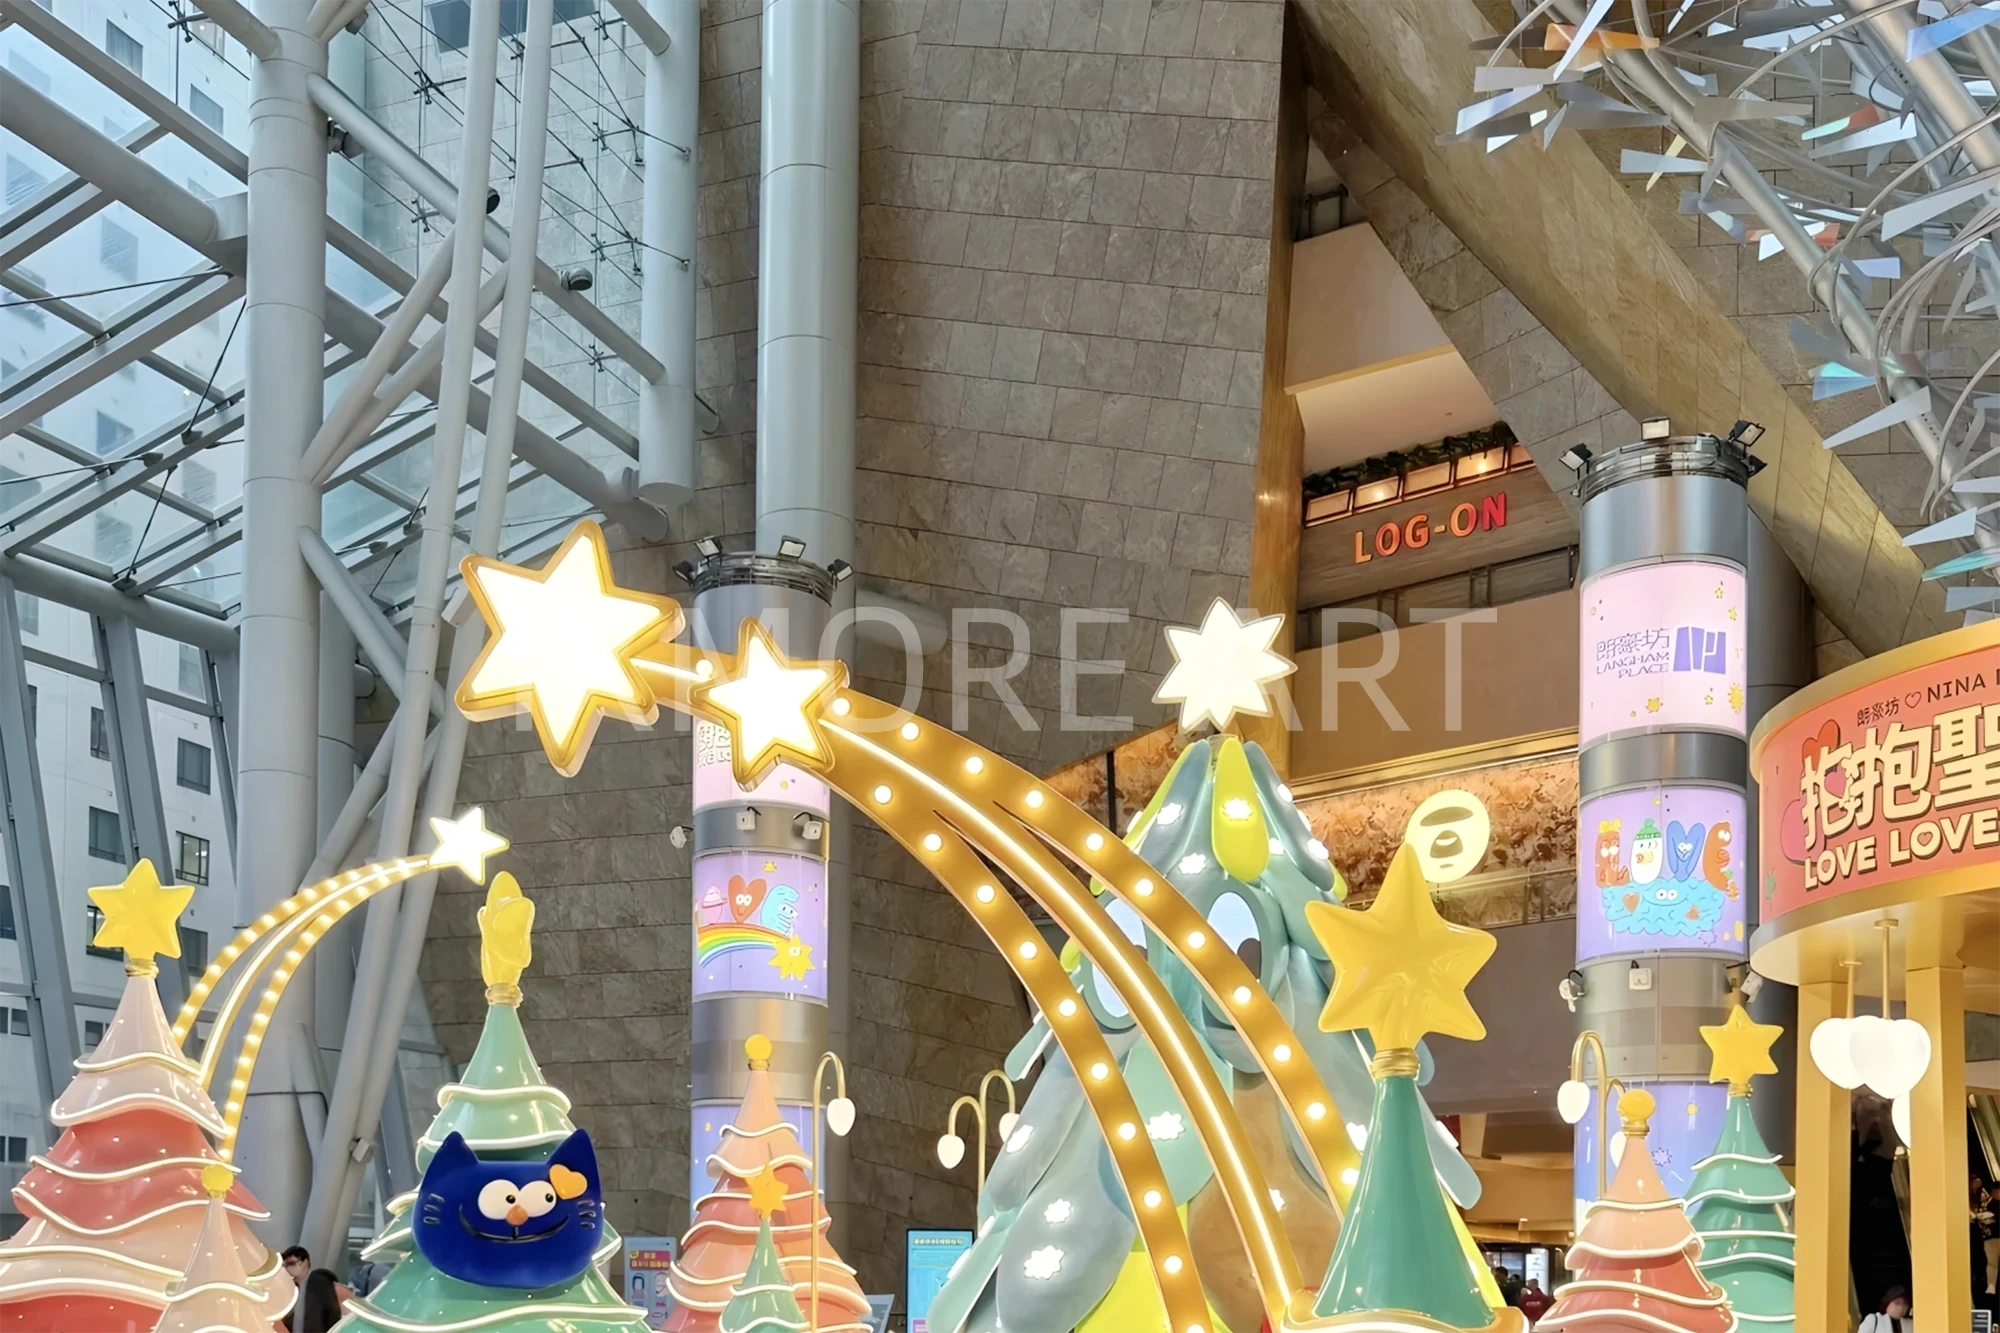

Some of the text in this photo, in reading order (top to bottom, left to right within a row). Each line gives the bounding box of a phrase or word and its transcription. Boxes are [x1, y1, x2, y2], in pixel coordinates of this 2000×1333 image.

[1354, 491, 1507, 564] LOG-ON
[1597, 652, 1670, 675] LANGHAM
[1618, 663, 1669, 679] PLACE
[1927, 673, 1986, 703] NINA
[1804, 808, 2000, 892] LOVE LOVE
